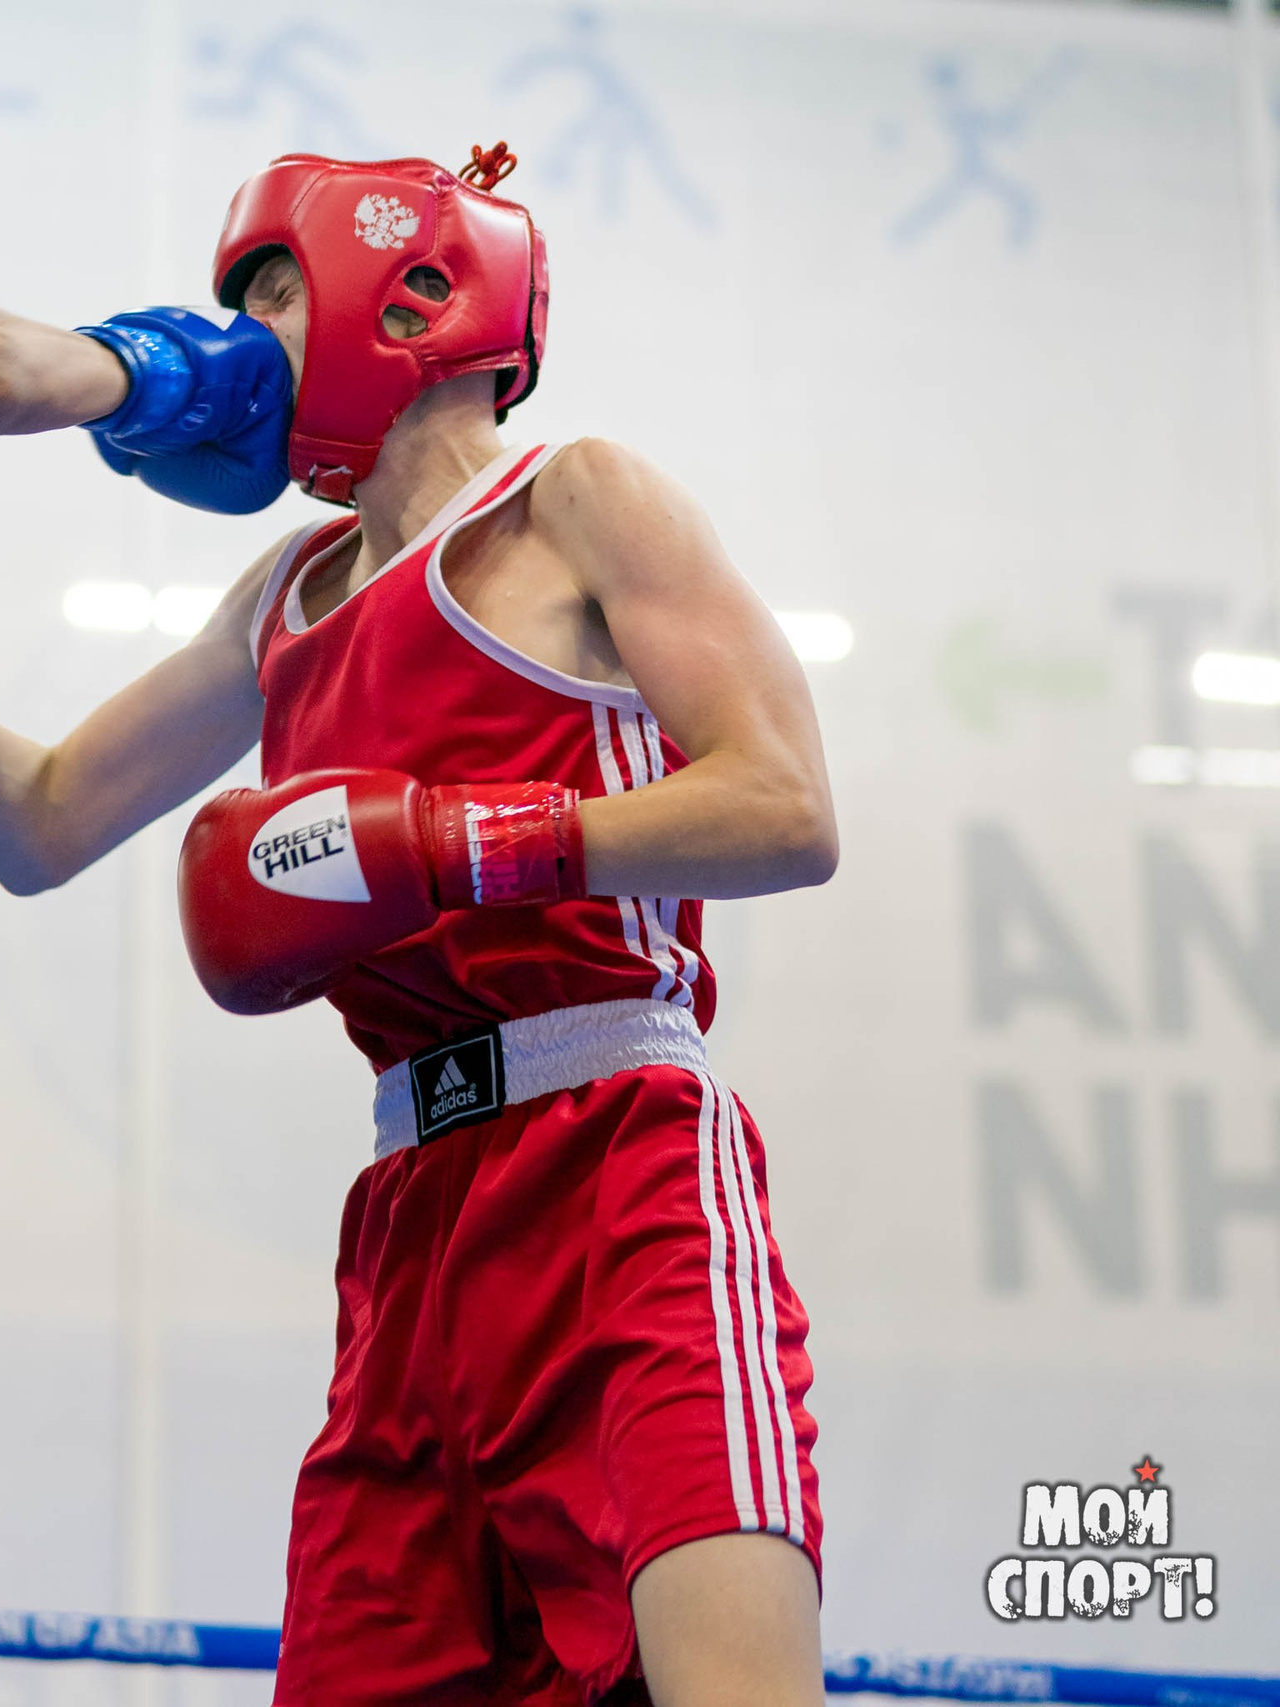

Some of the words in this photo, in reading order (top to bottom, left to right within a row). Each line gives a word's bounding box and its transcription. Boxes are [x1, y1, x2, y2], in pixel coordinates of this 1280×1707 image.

[253, 814, 346, 860] GREEN
[264, 836, 345, 879] HILL
[430, 1089, 478, 1119] adidas
